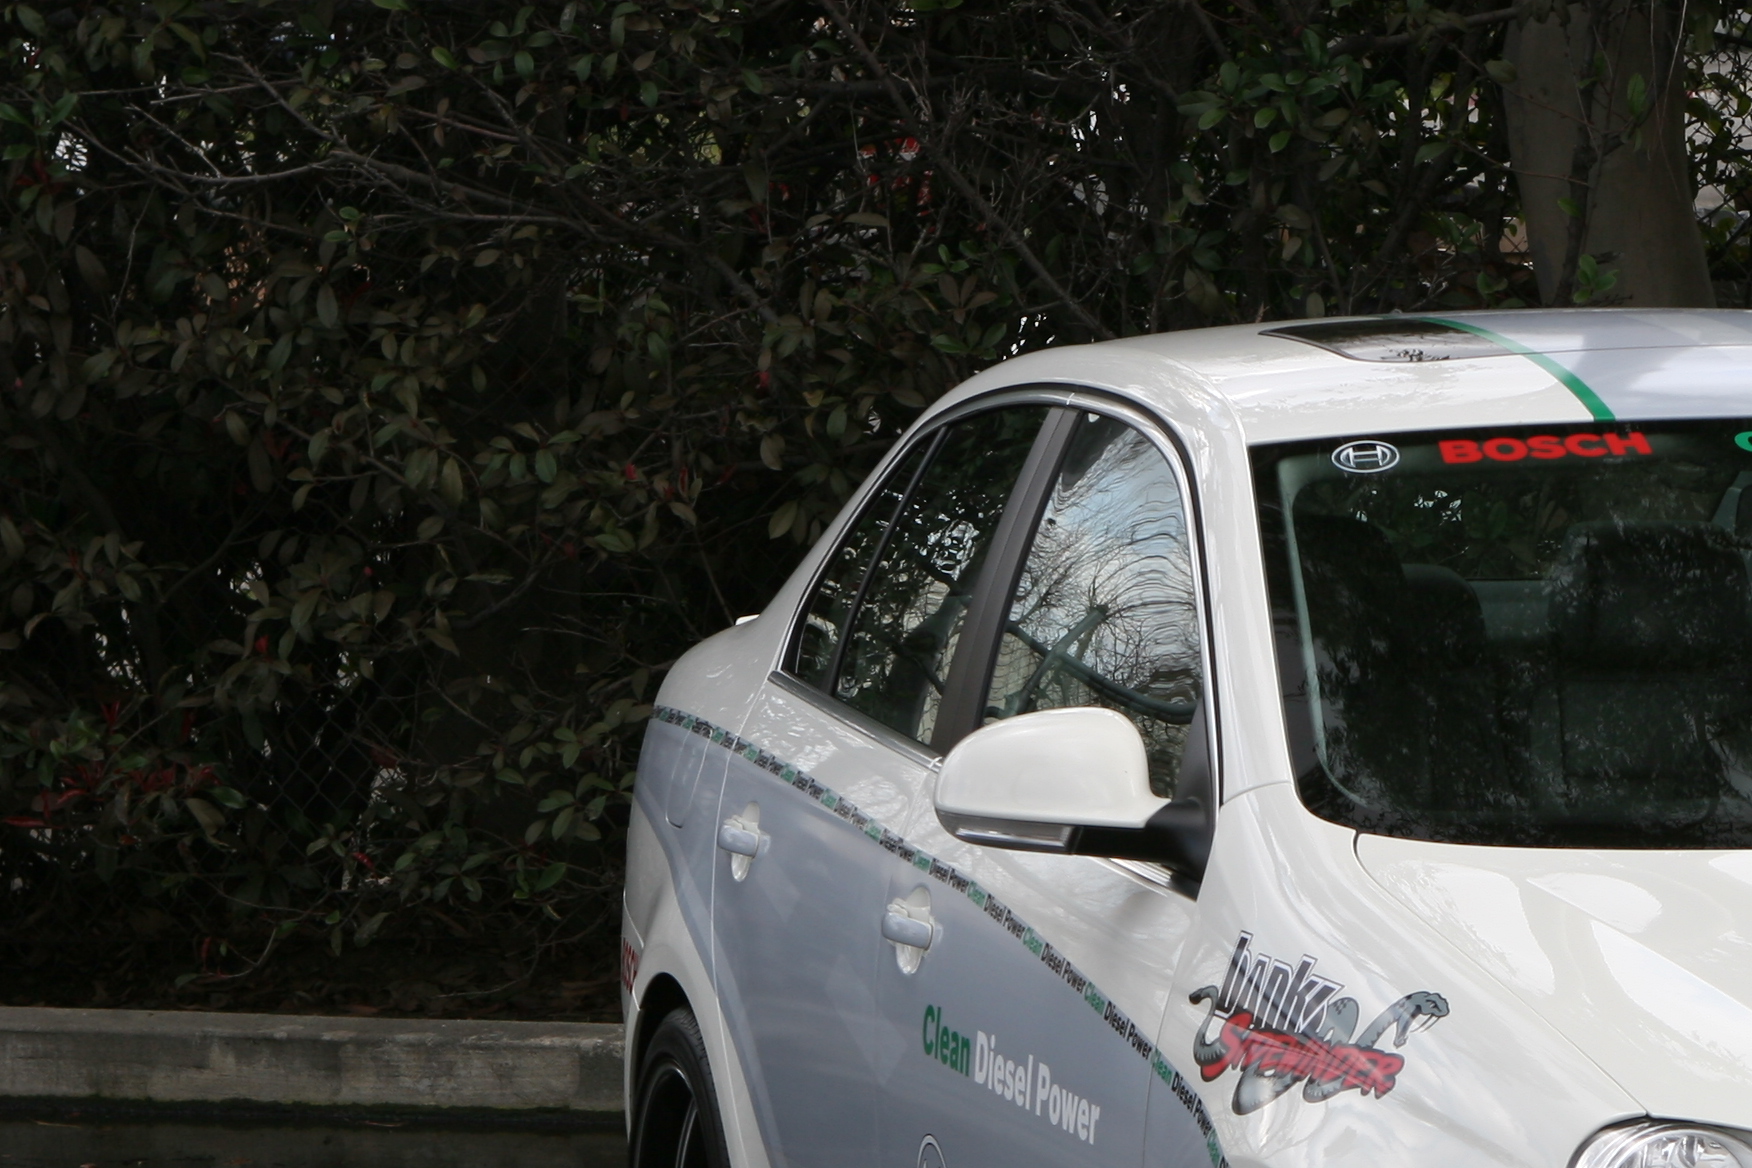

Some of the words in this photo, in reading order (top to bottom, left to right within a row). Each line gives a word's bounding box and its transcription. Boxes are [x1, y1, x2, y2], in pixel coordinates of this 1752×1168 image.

[1438, 432, 1652, 465] BOSCH
[922, 1004, 971, 1077] Clean
[974, 1029, 1034, 1111] Diesel
[1035, 1062, 1101, 1146] Power
[1062, 960, 1087, 993] Power
[1103, 1000, 1130, 1038] Diesel
[1126, 1022, 1153, 1060] Power
[1171, 1071, 1198, 1113] Diesel
